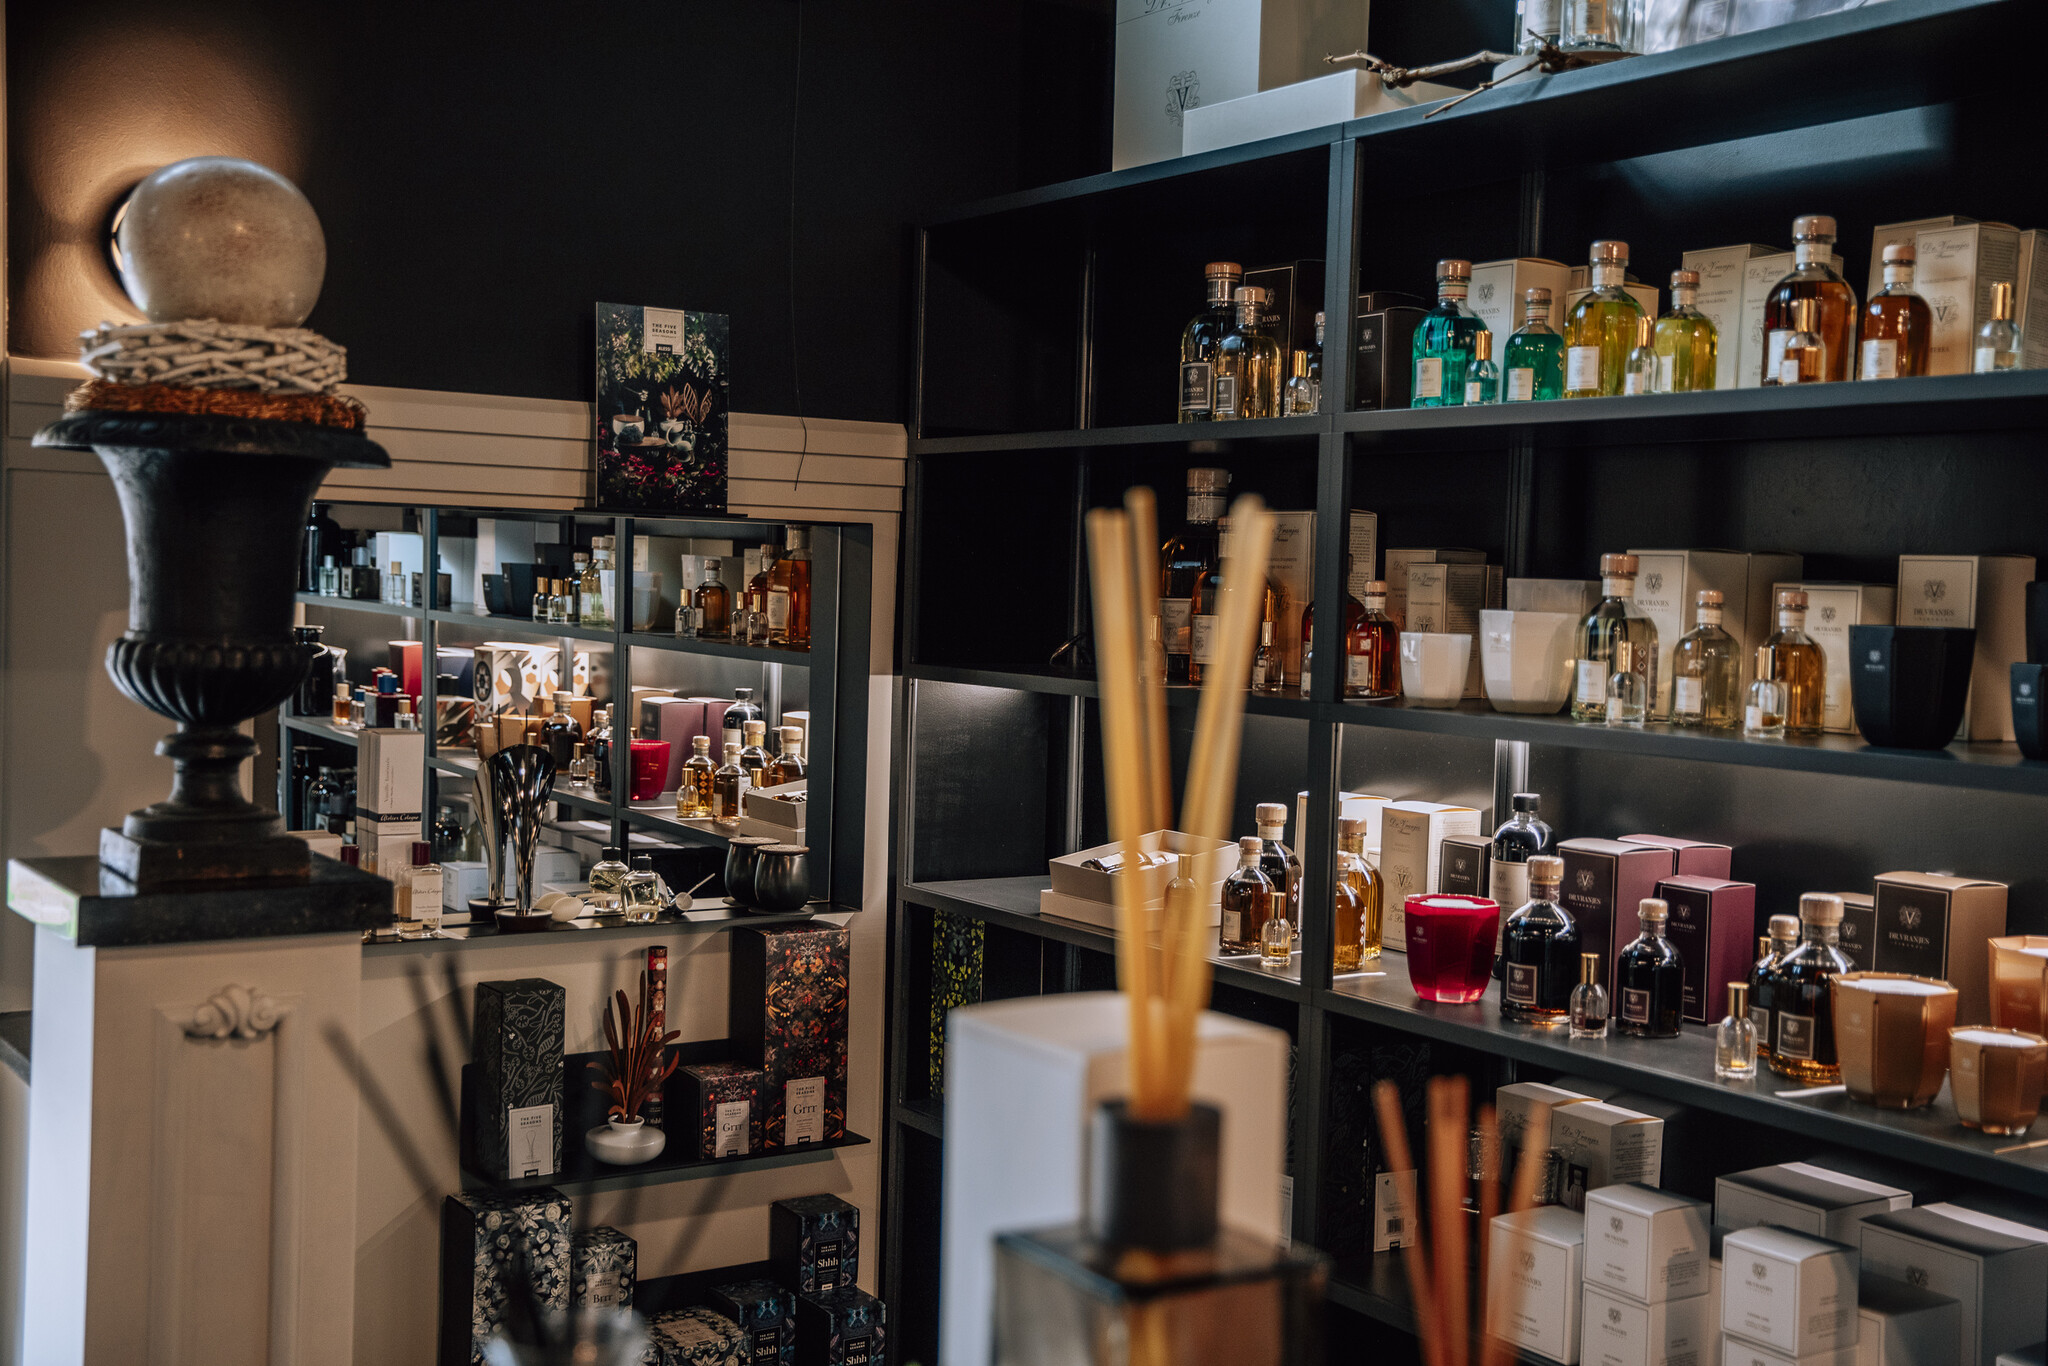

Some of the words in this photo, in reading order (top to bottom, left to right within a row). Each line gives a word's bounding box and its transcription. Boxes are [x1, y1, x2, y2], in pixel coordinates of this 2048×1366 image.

[793, 1104, 818, 1115] Grrr
[722, 1122, 743, 1132] Grrr
[817, 1257, 839, 1269] Shhh
[593, 1294, 613, 1304] Brrr
[756, 1345, 777, 1357] Shhh
[846, 1354, 867, 1366] Shhh
